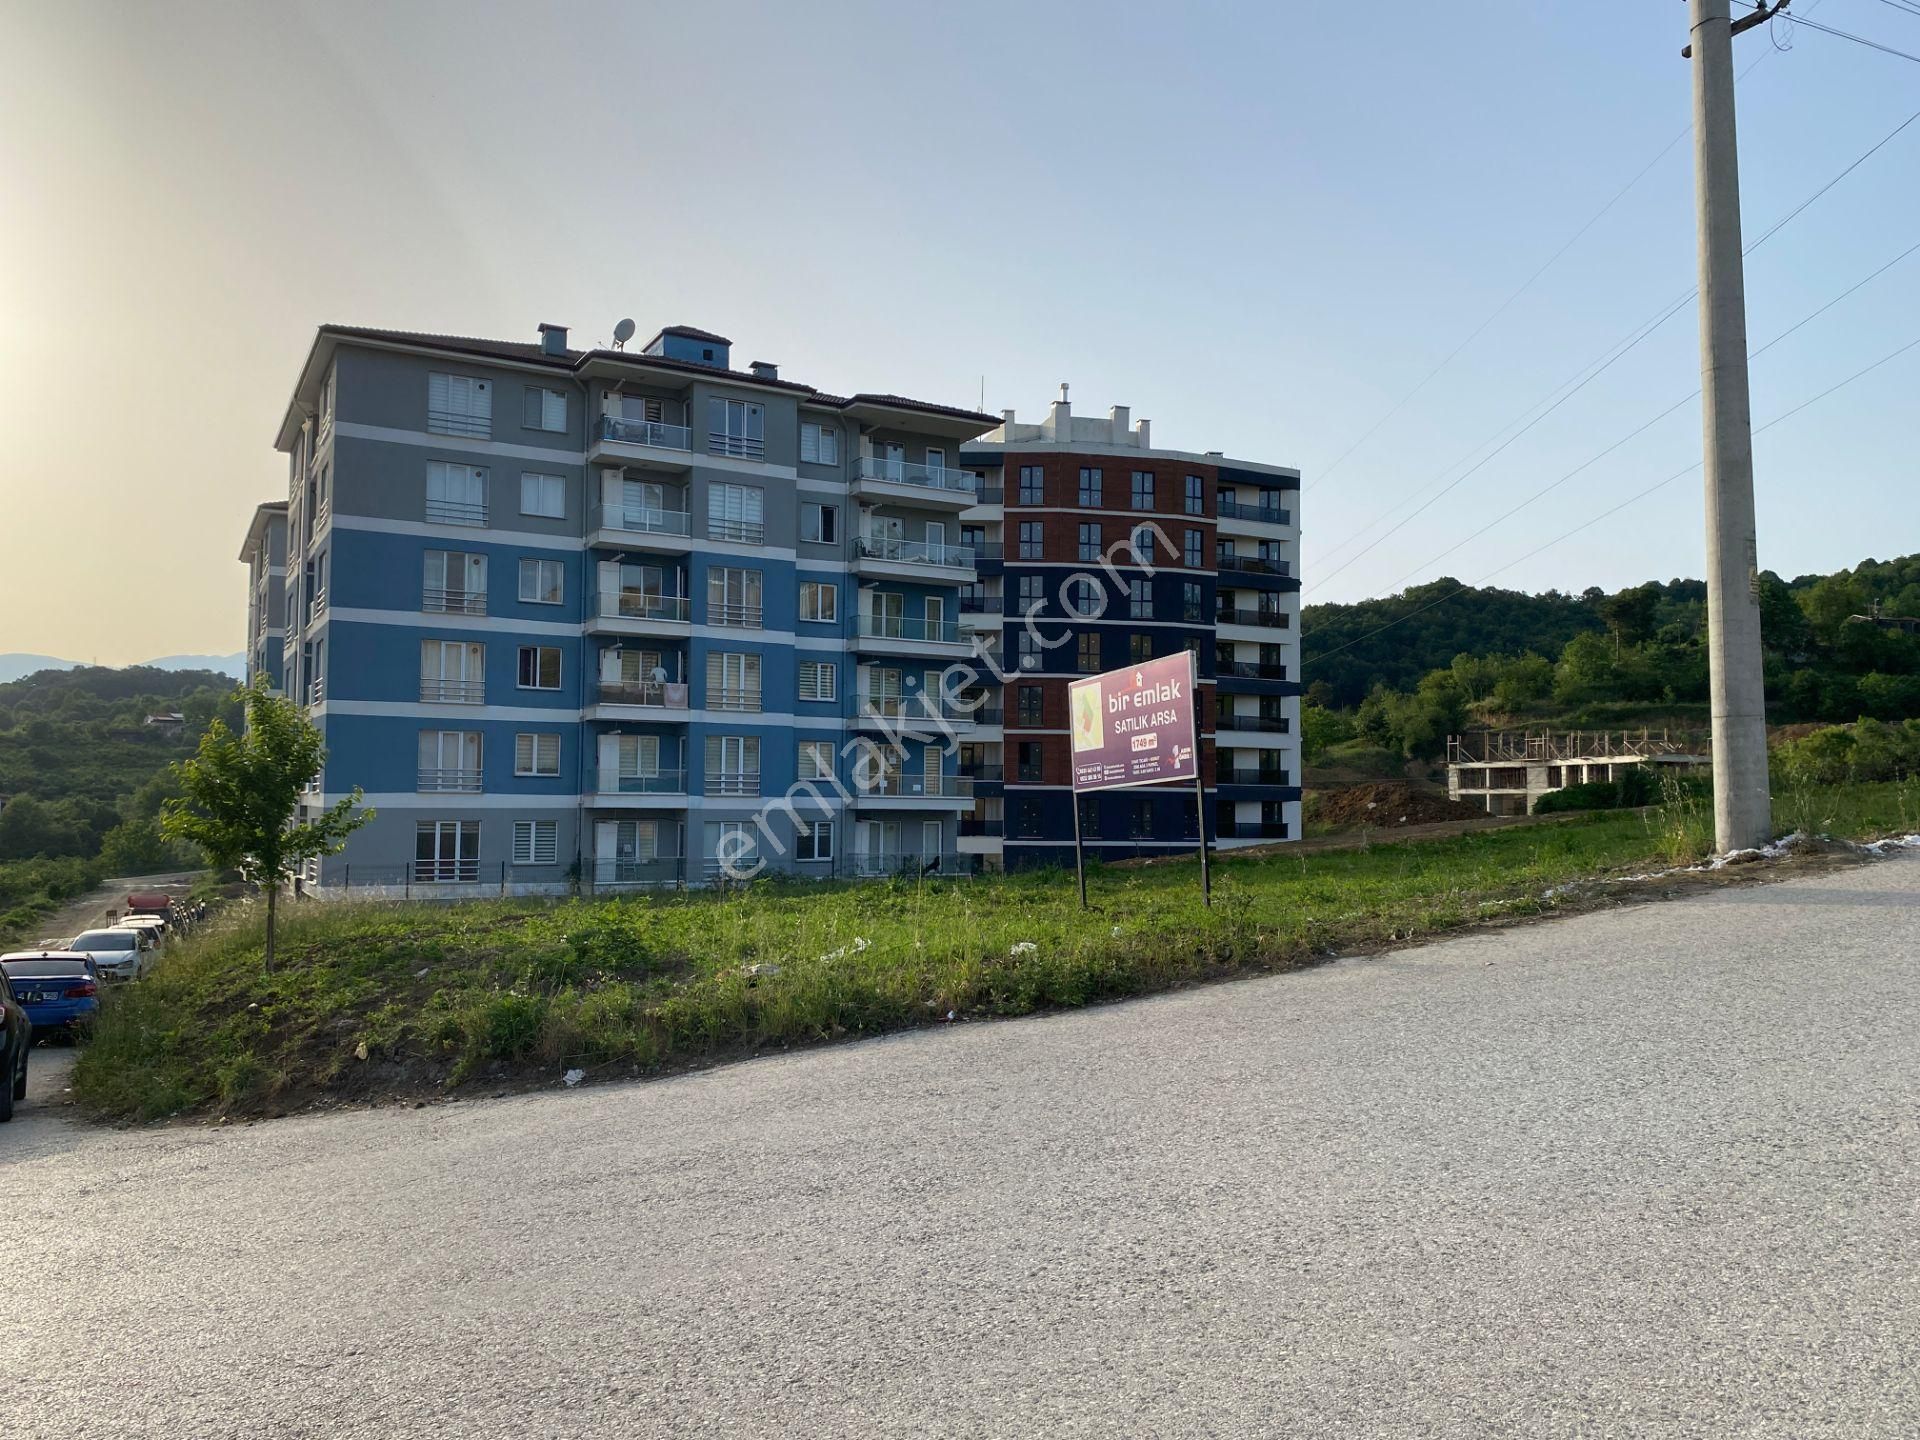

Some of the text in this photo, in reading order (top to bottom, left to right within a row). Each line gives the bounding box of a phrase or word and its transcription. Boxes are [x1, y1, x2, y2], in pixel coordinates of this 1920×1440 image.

[1108, 679, 1182, 713] bir emlak
[1115, 709, 1178, 734] SATILIK ARSA
[1132, 737, 1147, 749] 1749
